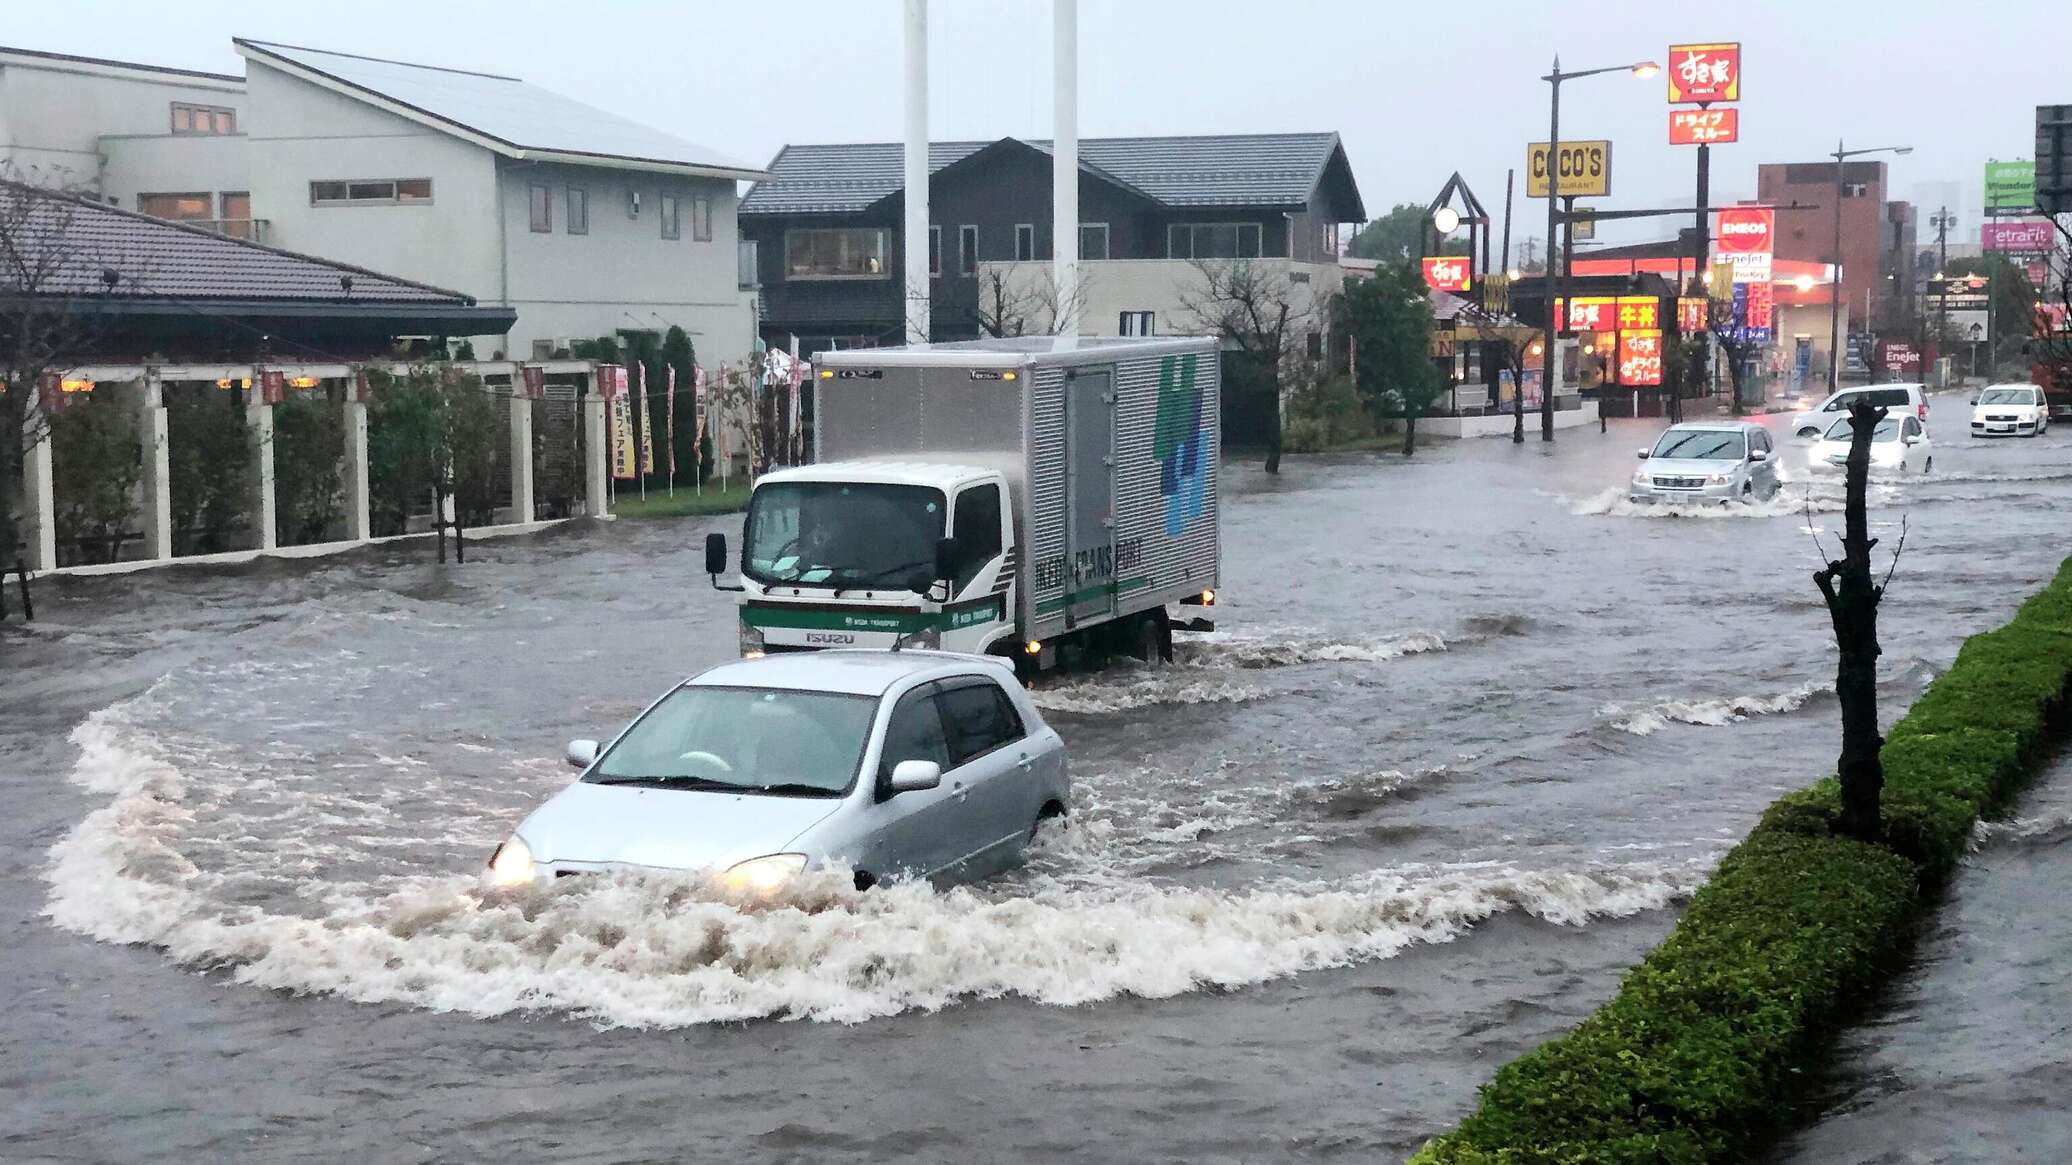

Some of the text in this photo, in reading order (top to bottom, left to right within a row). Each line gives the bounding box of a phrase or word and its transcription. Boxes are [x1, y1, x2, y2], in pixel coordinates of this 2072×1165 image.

[1678, 51, 1730, 87] すき家
[1675, 112, 1724, 128] ドライブ
[1692, 127, 1730, 141] スルー
[1533, 147, 1602, 178] CCO'S
[1538, 181, 1595, 191] RETAURANT
[1721, 222, 1767, 235] ENEOS
[1431, 260, 1462, 283] すき家
[1620, 304, 1655, 328] 牛丼
[1631, 356, 1661, 370] ドライブ
[1886, 352, 1920, 363] EneJet
[1634, 370, 1660, 382] スルー
[806, 632, 855, 644] ISUZU
